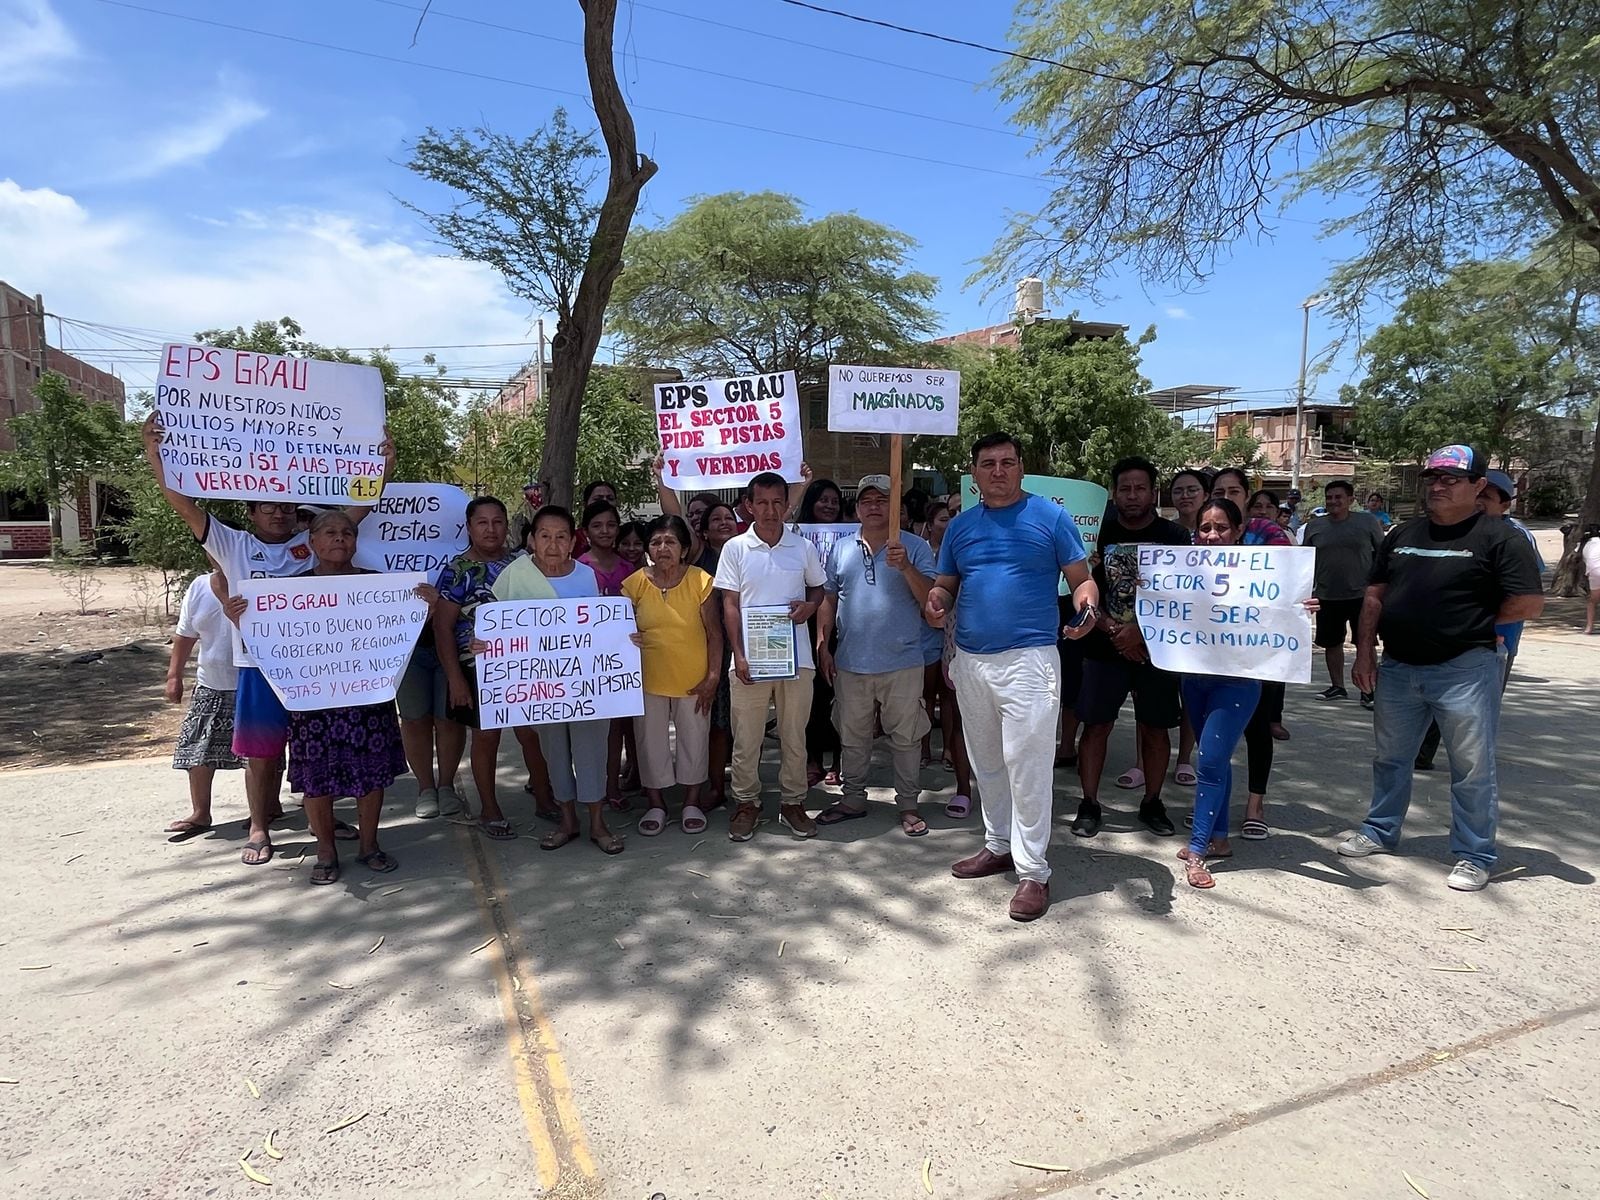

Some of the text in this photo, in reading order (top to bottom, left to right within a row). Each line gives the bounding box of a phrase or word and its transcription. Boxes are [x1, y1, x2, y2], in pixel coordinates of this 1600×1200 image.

[166, 346, 308, 391] EPS GRAU
[839, 369, 944, 386] NO QUEREMOS SER
[157, 385, 342, 421] POR NUESTROS NIÑOS
[659, 375, 785, 409] EPS GRAU
[156, 410, 343, 439] ADULTOS MAYORES Y
[659, 402, 781, 430] EL SECTOR 5
[161, 431, 242, 452] AMILIAS
[254, 438, 274, 452] NO
[286, 441, 361, 455] DETENGAN
[661, 422, 785, 450] PIDE PISTAS
[162, 448, 241, 468] PROGRESO
[336, 461, 383, 476] PISTAS
[668, 452, 782, 476] Y VEREDAS
[171, 472, 182, 489] Y
[195, 471, 291, 494] VEREDAS!
[298, 476, 349, 496] SECTOR
[372, 497, 440, 514] UEREMOS
[379, 520, 464, 542] PISTAS Y
[1070, 515, 1099, 526] ECTOR
[385, 554, 449, 571] VEREDA
[1140, 573, 1205, 590] SECTOR
[1211, 574, 1229, 596] 5
[256, 594, 287, 612] EPS
[292, 593, 338, 610] GRAU
[1139, 599, 1260, 623] DEBE SER
[251, 622, 270, 638] TU
[279, 622, 320, 638] VISTO
[326, 618, 371, 635] BUENO
[377, 614, 405, 629] PARA
[483, 604, 633, 631] SECTOR 5 DEL
[271, 641, 343, 660] GOBIERNO
[352, 632, 410, 651] REGIONAL
[484, 633, 591, 660] AA HH NUEVA
[1143, 626, 1298, 651] DISCRIMINADO
[300, 660, 363, 677] CUMPLIR
[484, 653, 623, 683] ESPERANZA MAS
[330, 682, 337, 697] Y
[481, 687, 502, 705] DE
[571, 679, 594, 697] SIN
[599, 672, 641, 695] PISTAS
[495, 700, 595, 724] NI VEREDAS
